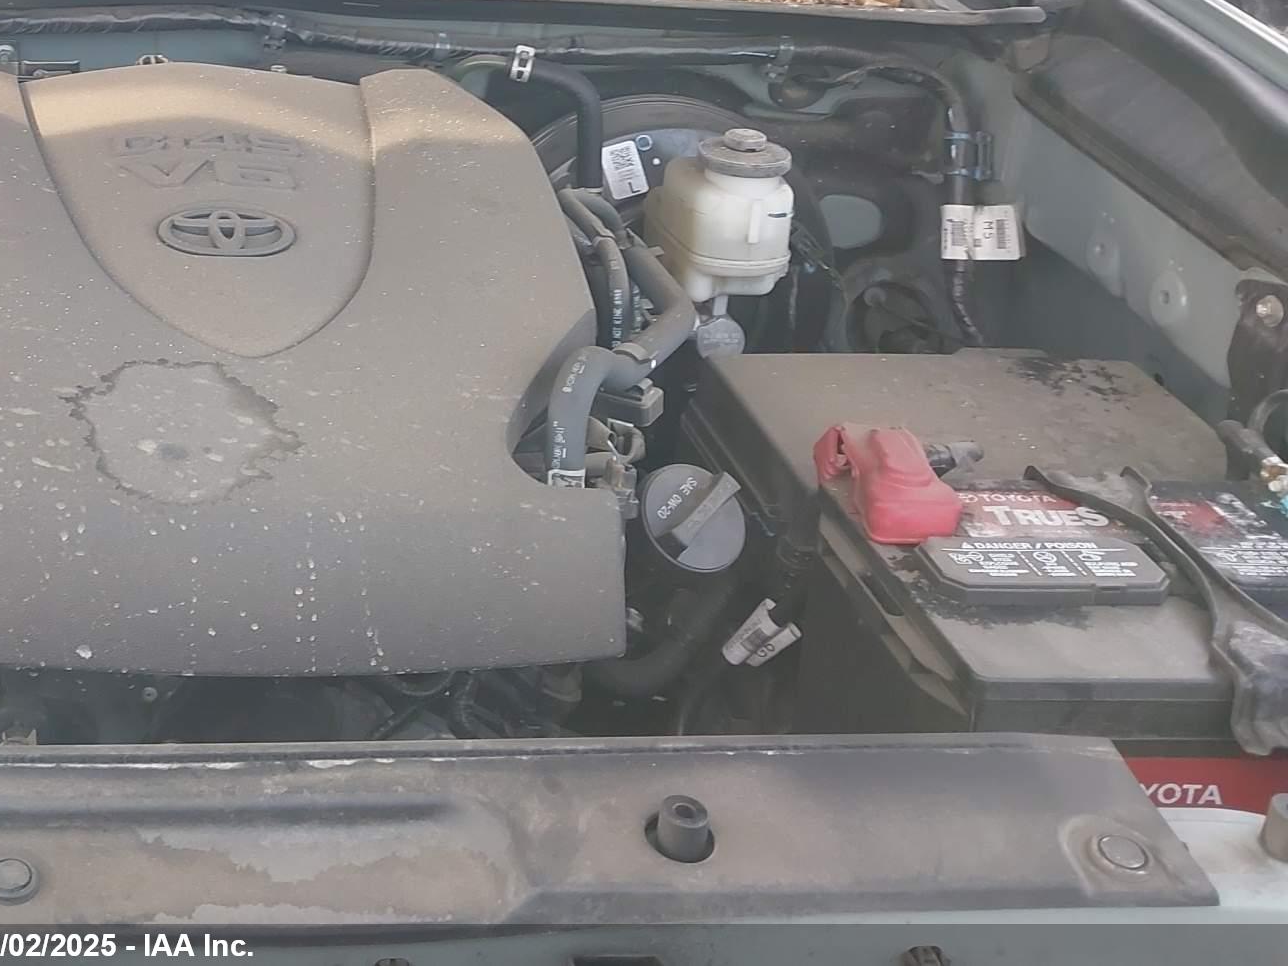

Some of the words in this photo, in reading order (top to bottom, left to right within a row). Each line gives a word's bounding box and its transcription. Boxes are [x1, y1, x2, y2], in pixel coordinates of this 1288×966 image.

[679, 476, 698, 496] SAE
[978, 493, 1057, 503] TOYOTA
[974, 541, 1032, 549] DANGER
[1044, 541, 1098, 549] POISON
